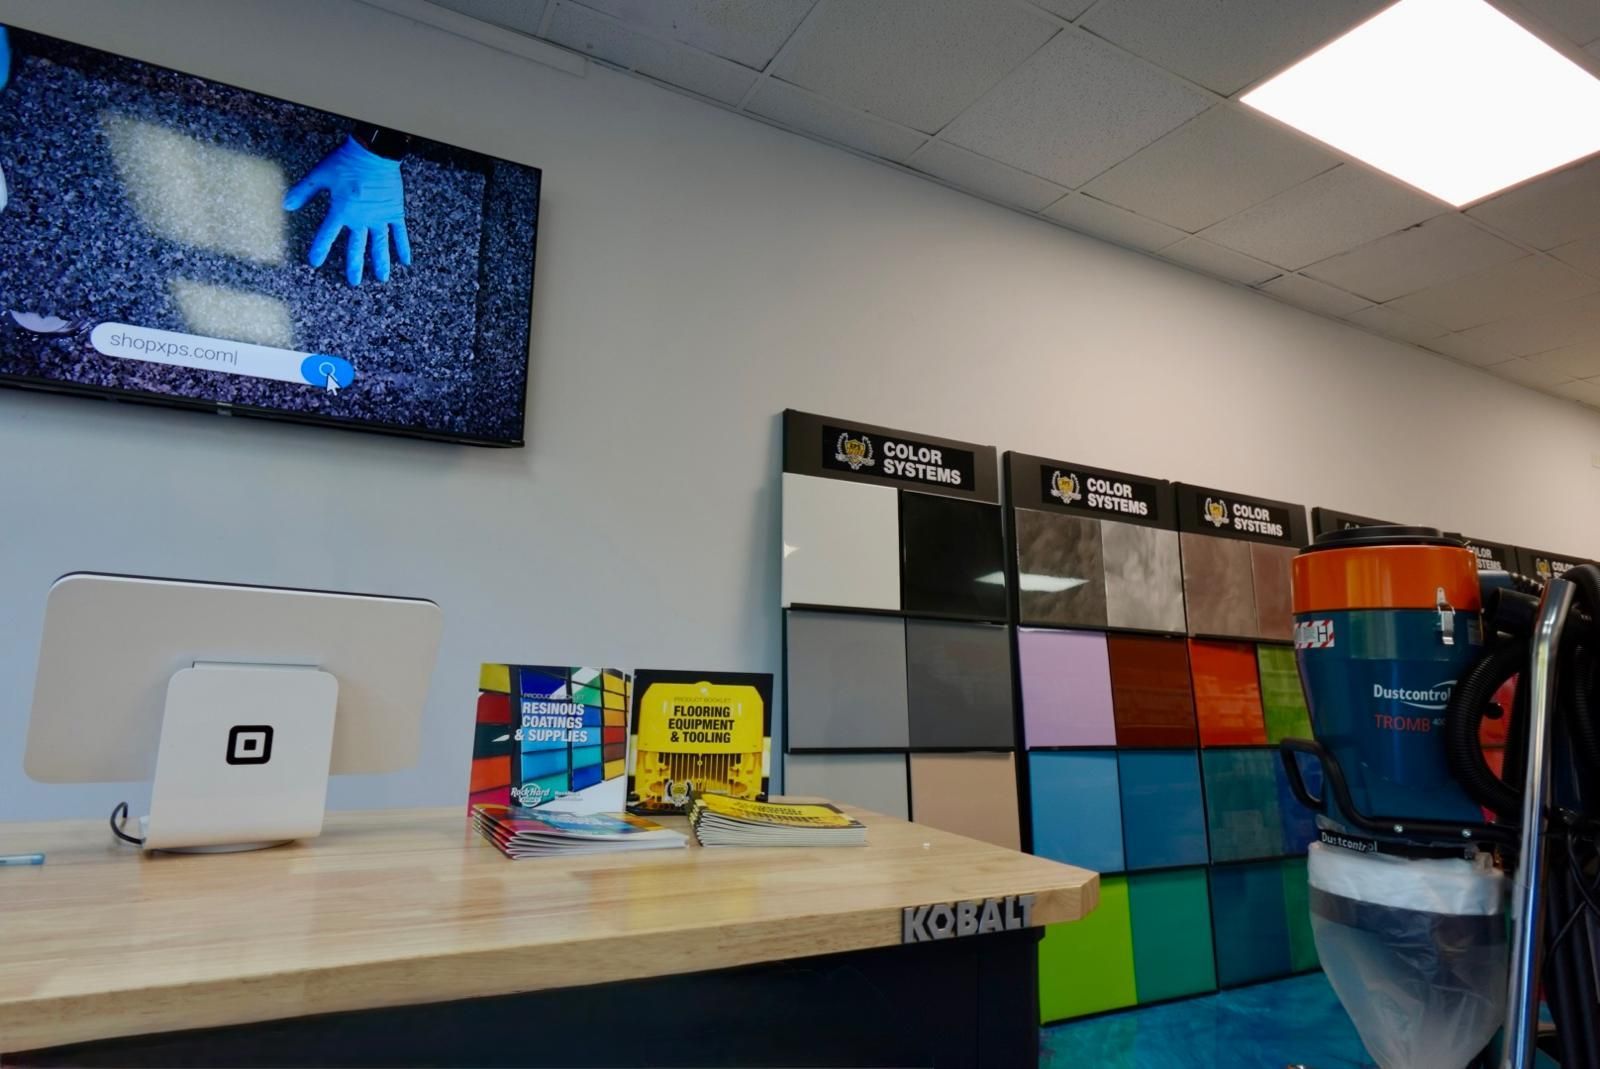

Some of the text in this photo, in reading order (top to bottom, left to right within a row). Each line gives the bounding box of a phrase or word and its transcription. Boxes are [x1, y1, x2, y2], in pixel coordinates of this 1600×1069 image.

[883, 441, 943, 465] COLOR
[883, 458, 962, 485] SYSTEMS
[1086, 477, 1132, 498] COLOR
[1087, 493, 1148, 515] SYSTEMS
[1232, 503, 1270, 521] COLOR
[1234, 517, 1283, 537] SYSTEMS
[1373, 684, 1451, 701] Dustcontrol
[522, 702, 585, 716] RESINOUS
[673, 705, 731, 718] FLOORING
[522, 715, 583, 729] COATINGS
[668, 718, 735, 731] EQUIPMENT
[1374, 713, 1430, 732] TROMB
[514, 728, 588, 742] & SUPPLIES
[670, 731, 731, 744] & TOOLING
[903, 895, 1037, 944] KOBALT
